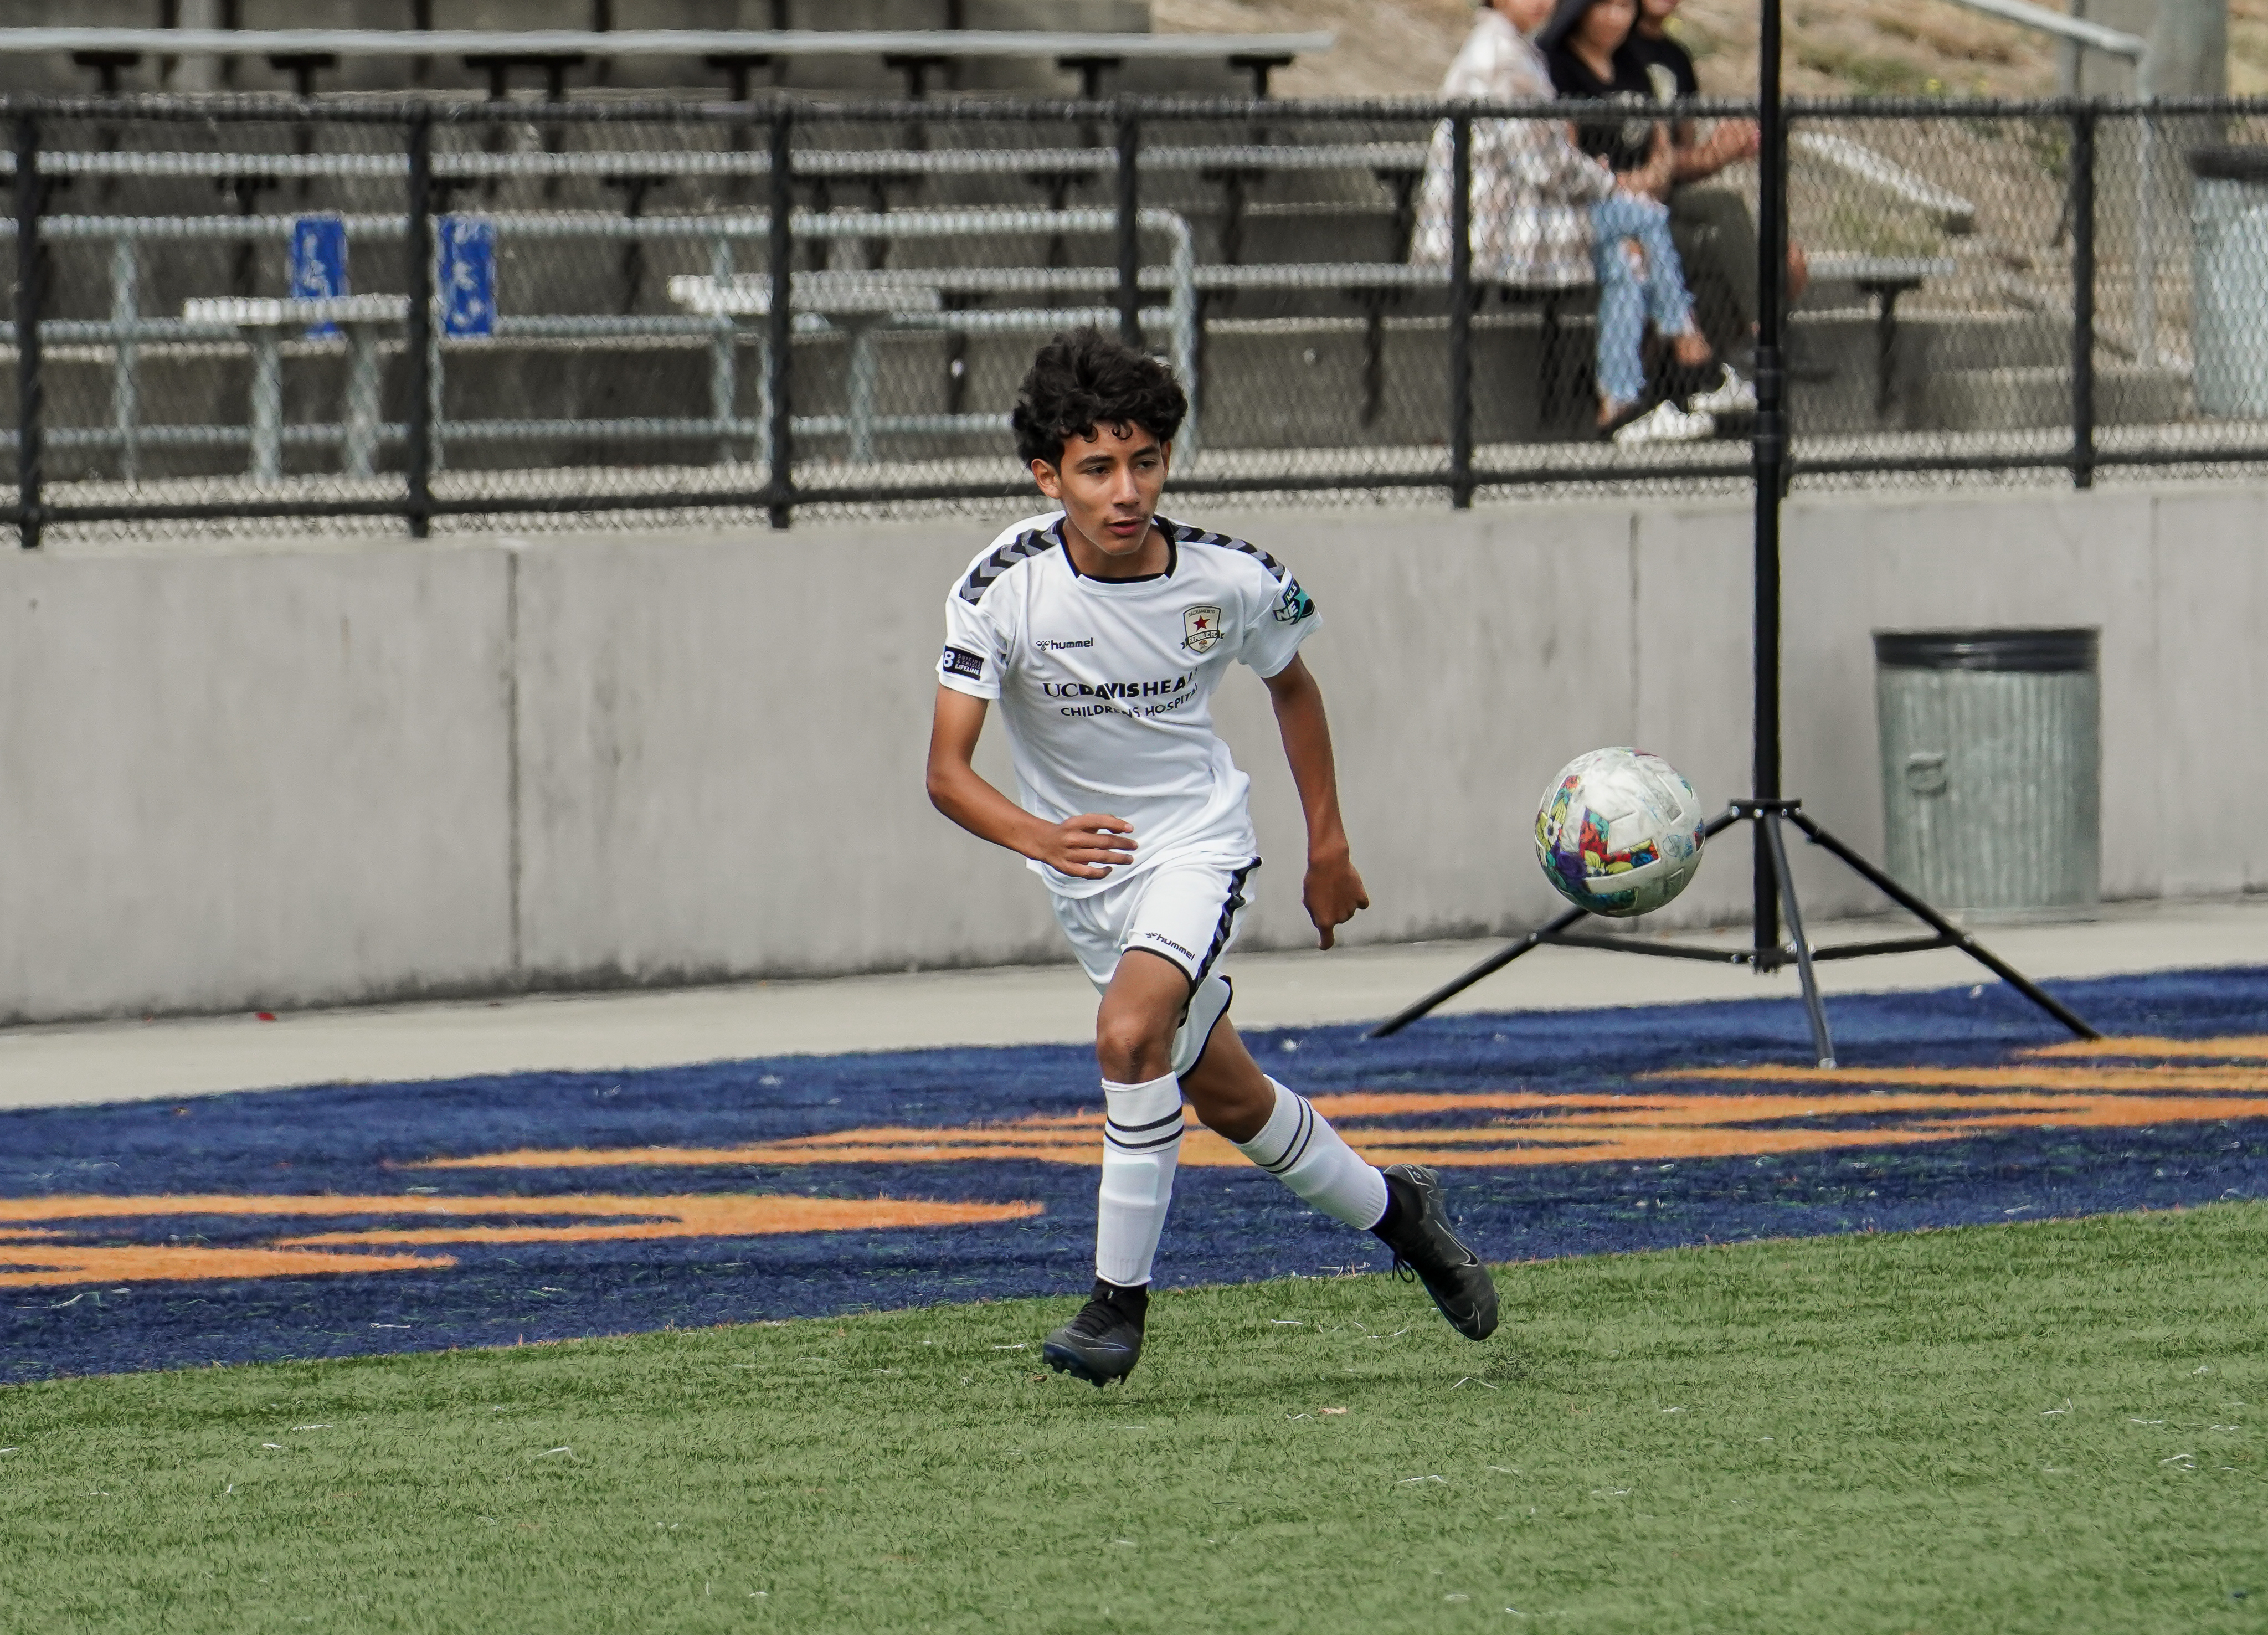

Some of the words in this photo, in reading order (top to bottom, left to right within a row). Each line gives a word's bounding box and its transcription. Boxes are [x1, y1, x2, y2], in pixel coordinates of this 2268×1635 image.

[1287, 584, 1297, 601] MLS
[1051, 637, 1093, 650] hummel
[955, 664, 980, 675] LIFELINE
[1143, 665, 1200, 697] HEA
[1156, 934, 1195, 961] hummel
